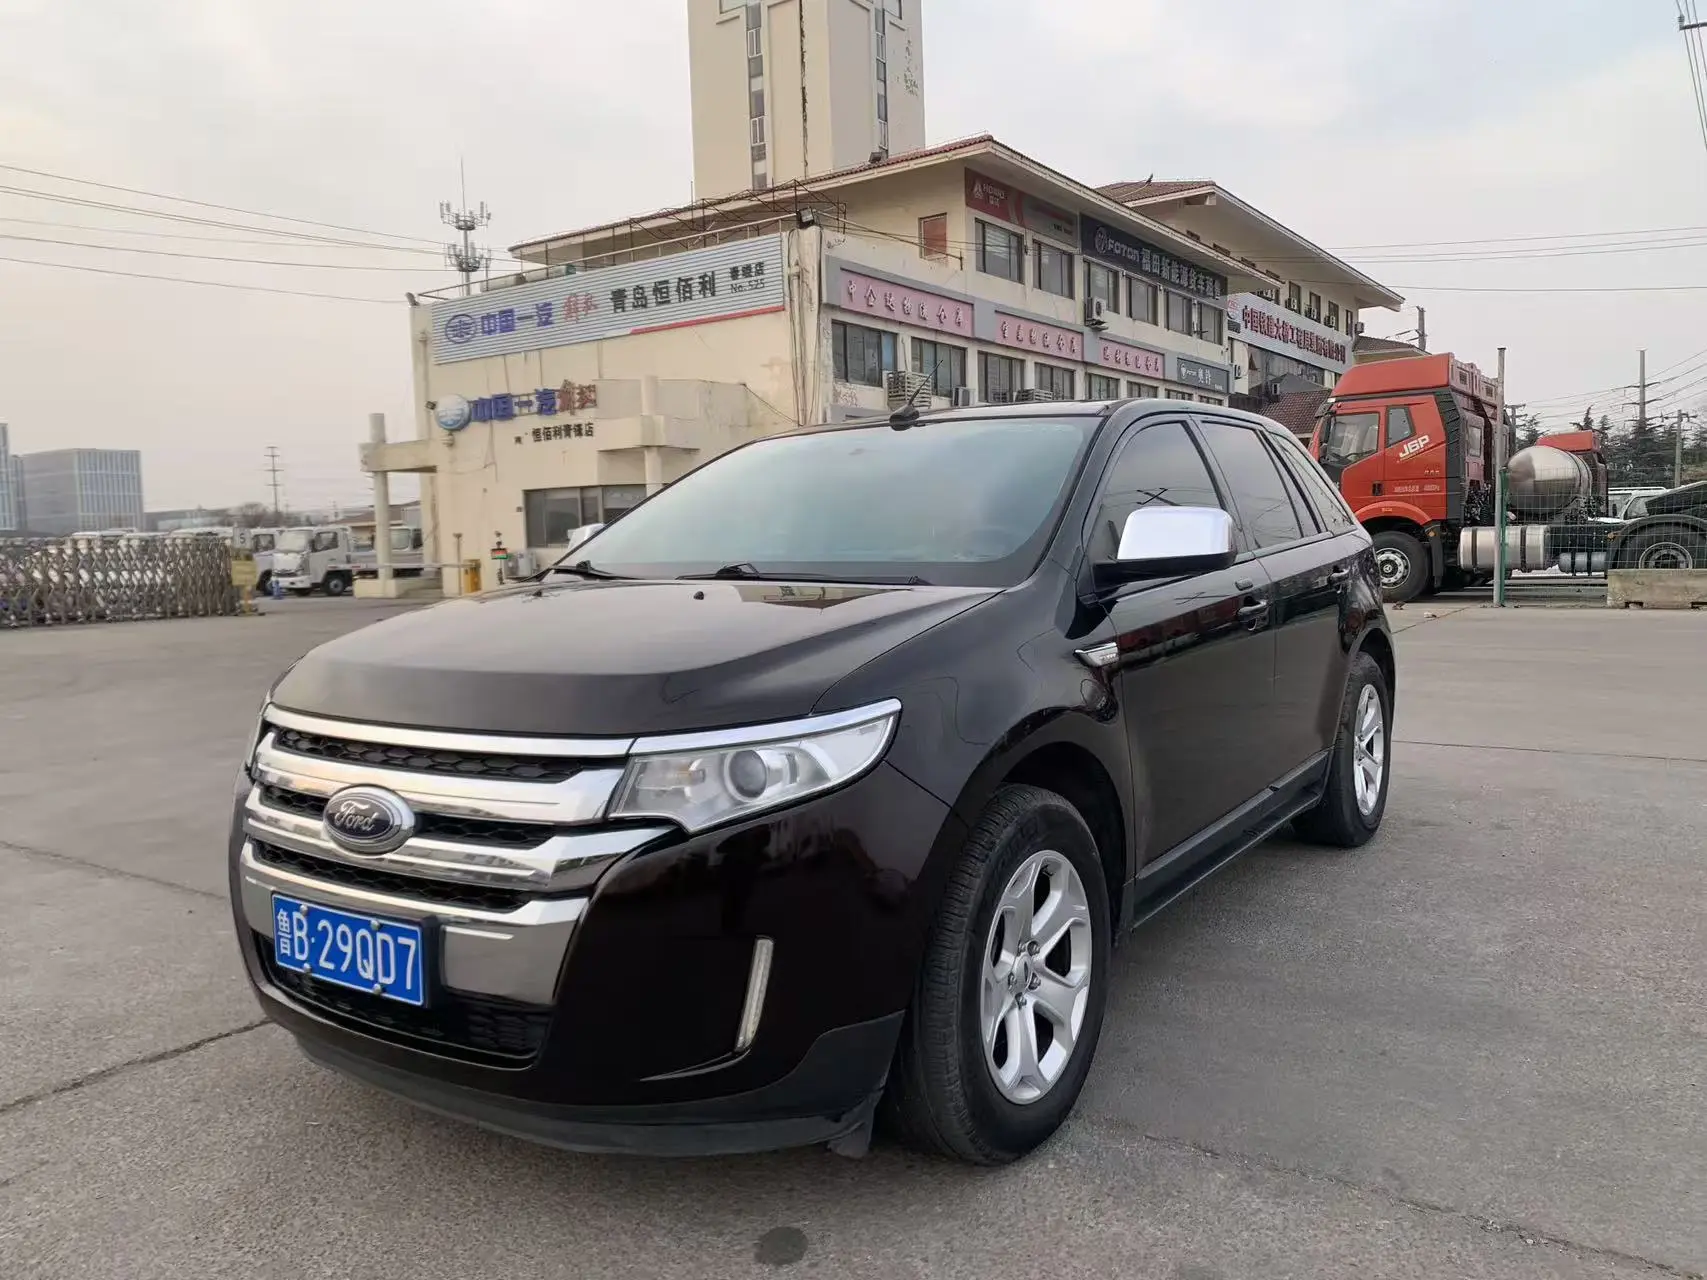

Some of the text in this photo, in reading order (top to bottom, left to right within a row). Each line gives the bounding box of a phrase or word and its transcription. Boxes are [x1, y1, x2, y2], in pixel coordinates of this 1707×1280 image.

[610, 271, 716, 313] 青岛恒佰利
[334, 801, 380, 832] Ford
